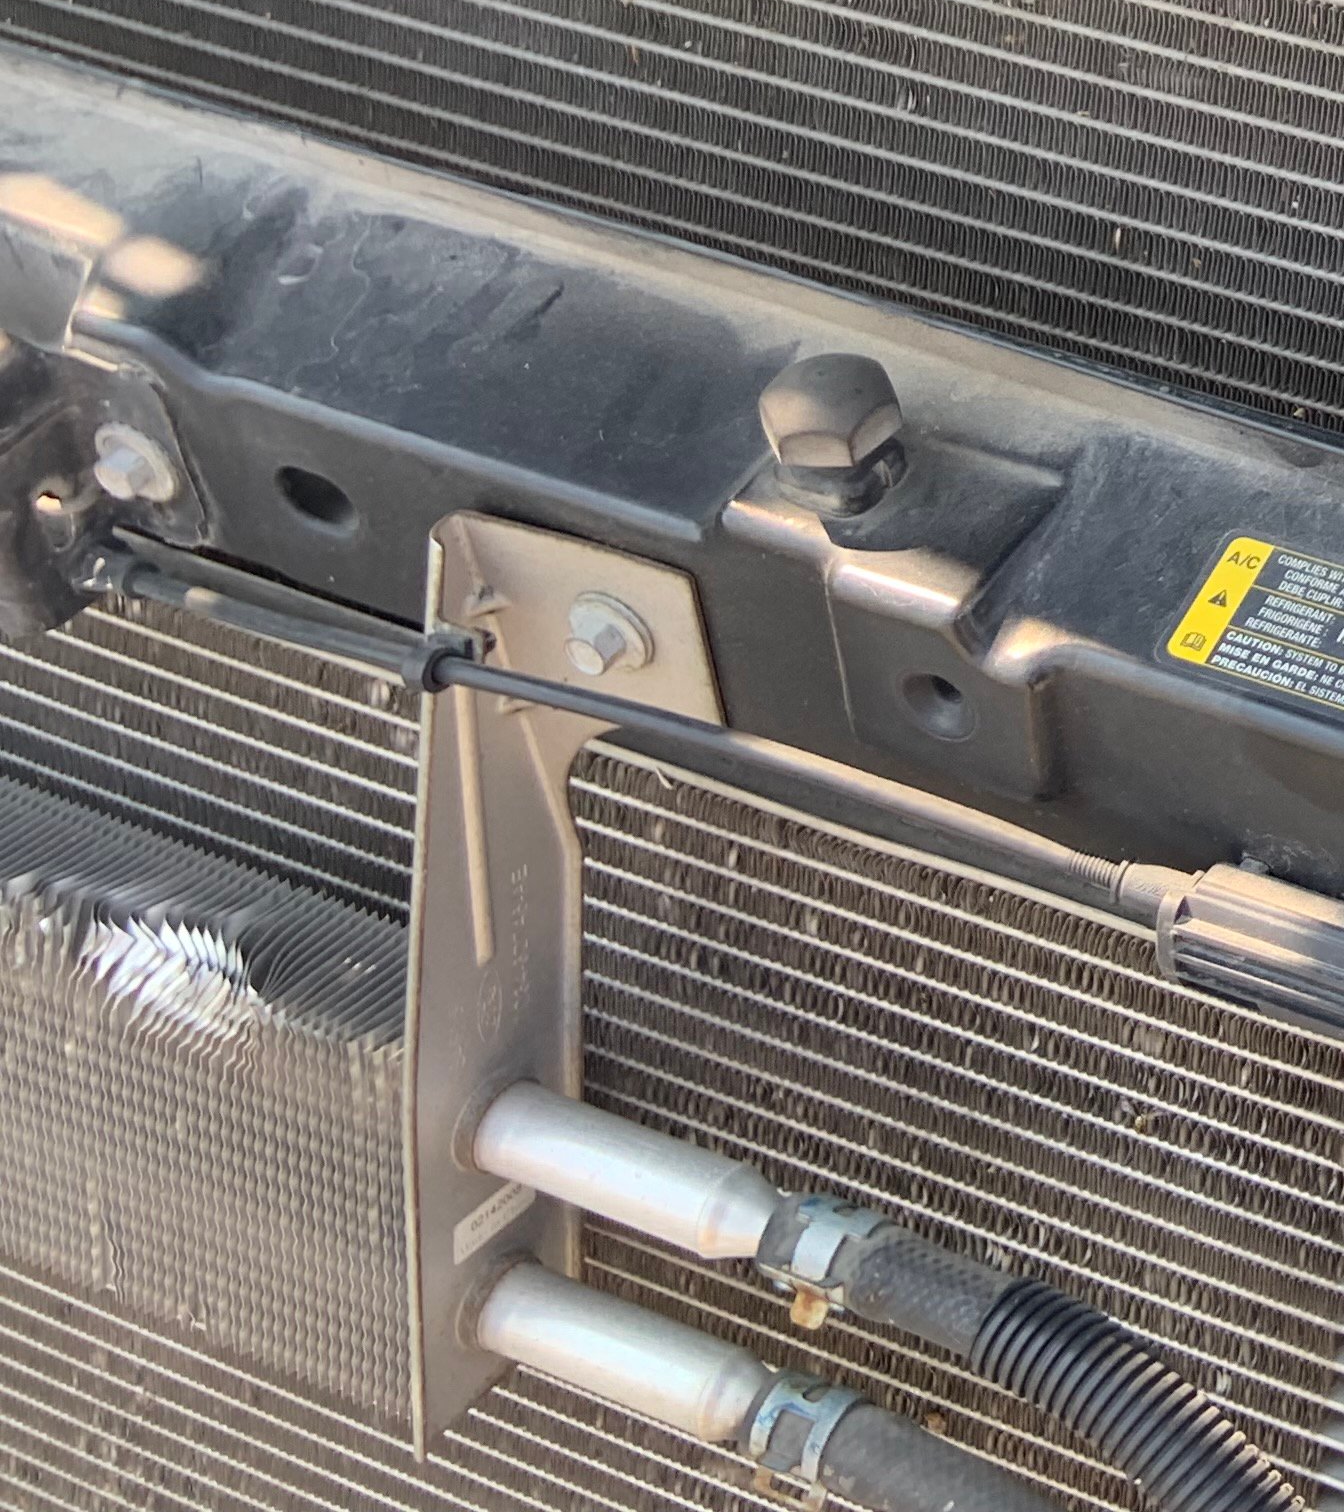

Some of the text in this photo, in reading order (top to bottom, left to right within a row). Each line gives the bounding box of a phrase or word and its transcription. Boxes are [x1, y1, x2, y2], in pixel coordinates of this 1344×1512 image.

[1226, 552, 1261, 569] A/C
[1278, 555, 1328, 576] COMPLIES
[1278, 581, 1344, 608] DEBE CUPLIR:
[1284, 570, 1339, 592] CONFORME
[1265, 596, 1335, 621] REFRIGERANT:
[1245, 618, 1321, 647] REFRIGERANTE:
[1218, 643, 1251, 658] MISE
[1250, 653, 1271, 665] EN
[1272, 660, 1319, 680] GARDE:
[1319, 675, 1335, 685] NE
[1226, 632, 1284, 654] CAUTION:
[1285, 650, 1324, 666] SYSTEM
[1324, 661, 1338, 672] TO
[1211, 656, 1294, 686] PRECAUCIÓN:
[1294, 681, 1307, 692] EL
